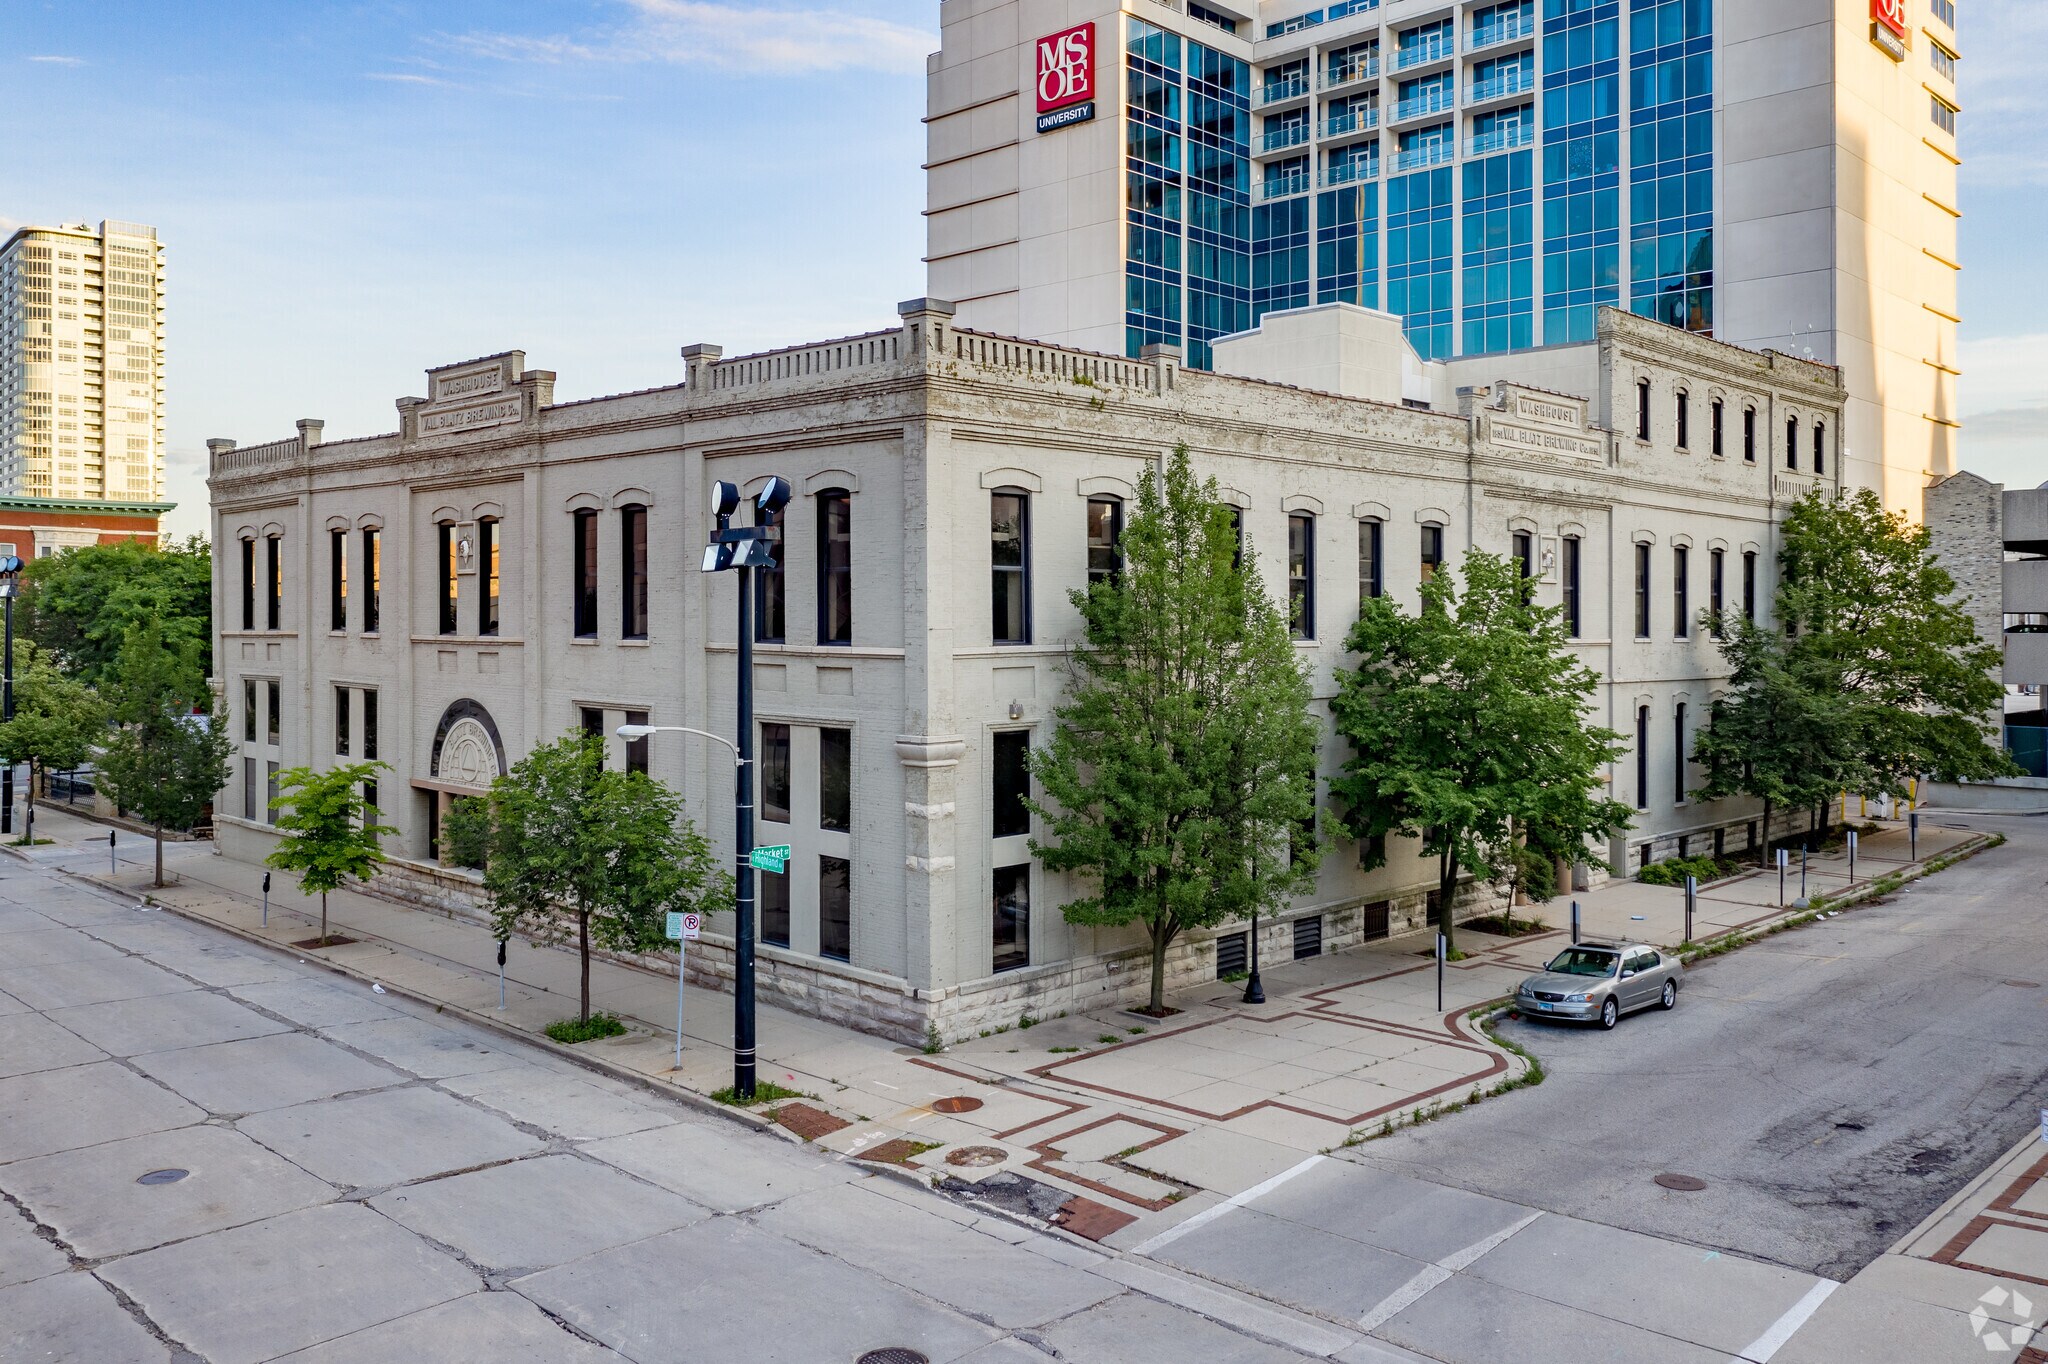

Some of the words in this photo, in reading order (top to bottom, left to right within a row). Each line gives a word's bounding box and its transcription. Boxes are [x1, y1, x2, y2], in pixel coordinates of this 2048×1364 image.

[1039, 106, 1088, 128] UNIVERSITY
[443, 373, 498, 395] WASHHOUSE
[440, 411, 464, 428] BLATZ
[466, 404, 505, 423] BREWING
[1520, 400, 1574, 422] WASHHOUSE
[1519, 430, 1542, 446] BLATZ
[1544, 435, 1577, 452] BREWING
[469, 724, 495, 761] BREWING
[755, 853, 779, 868] Highland
